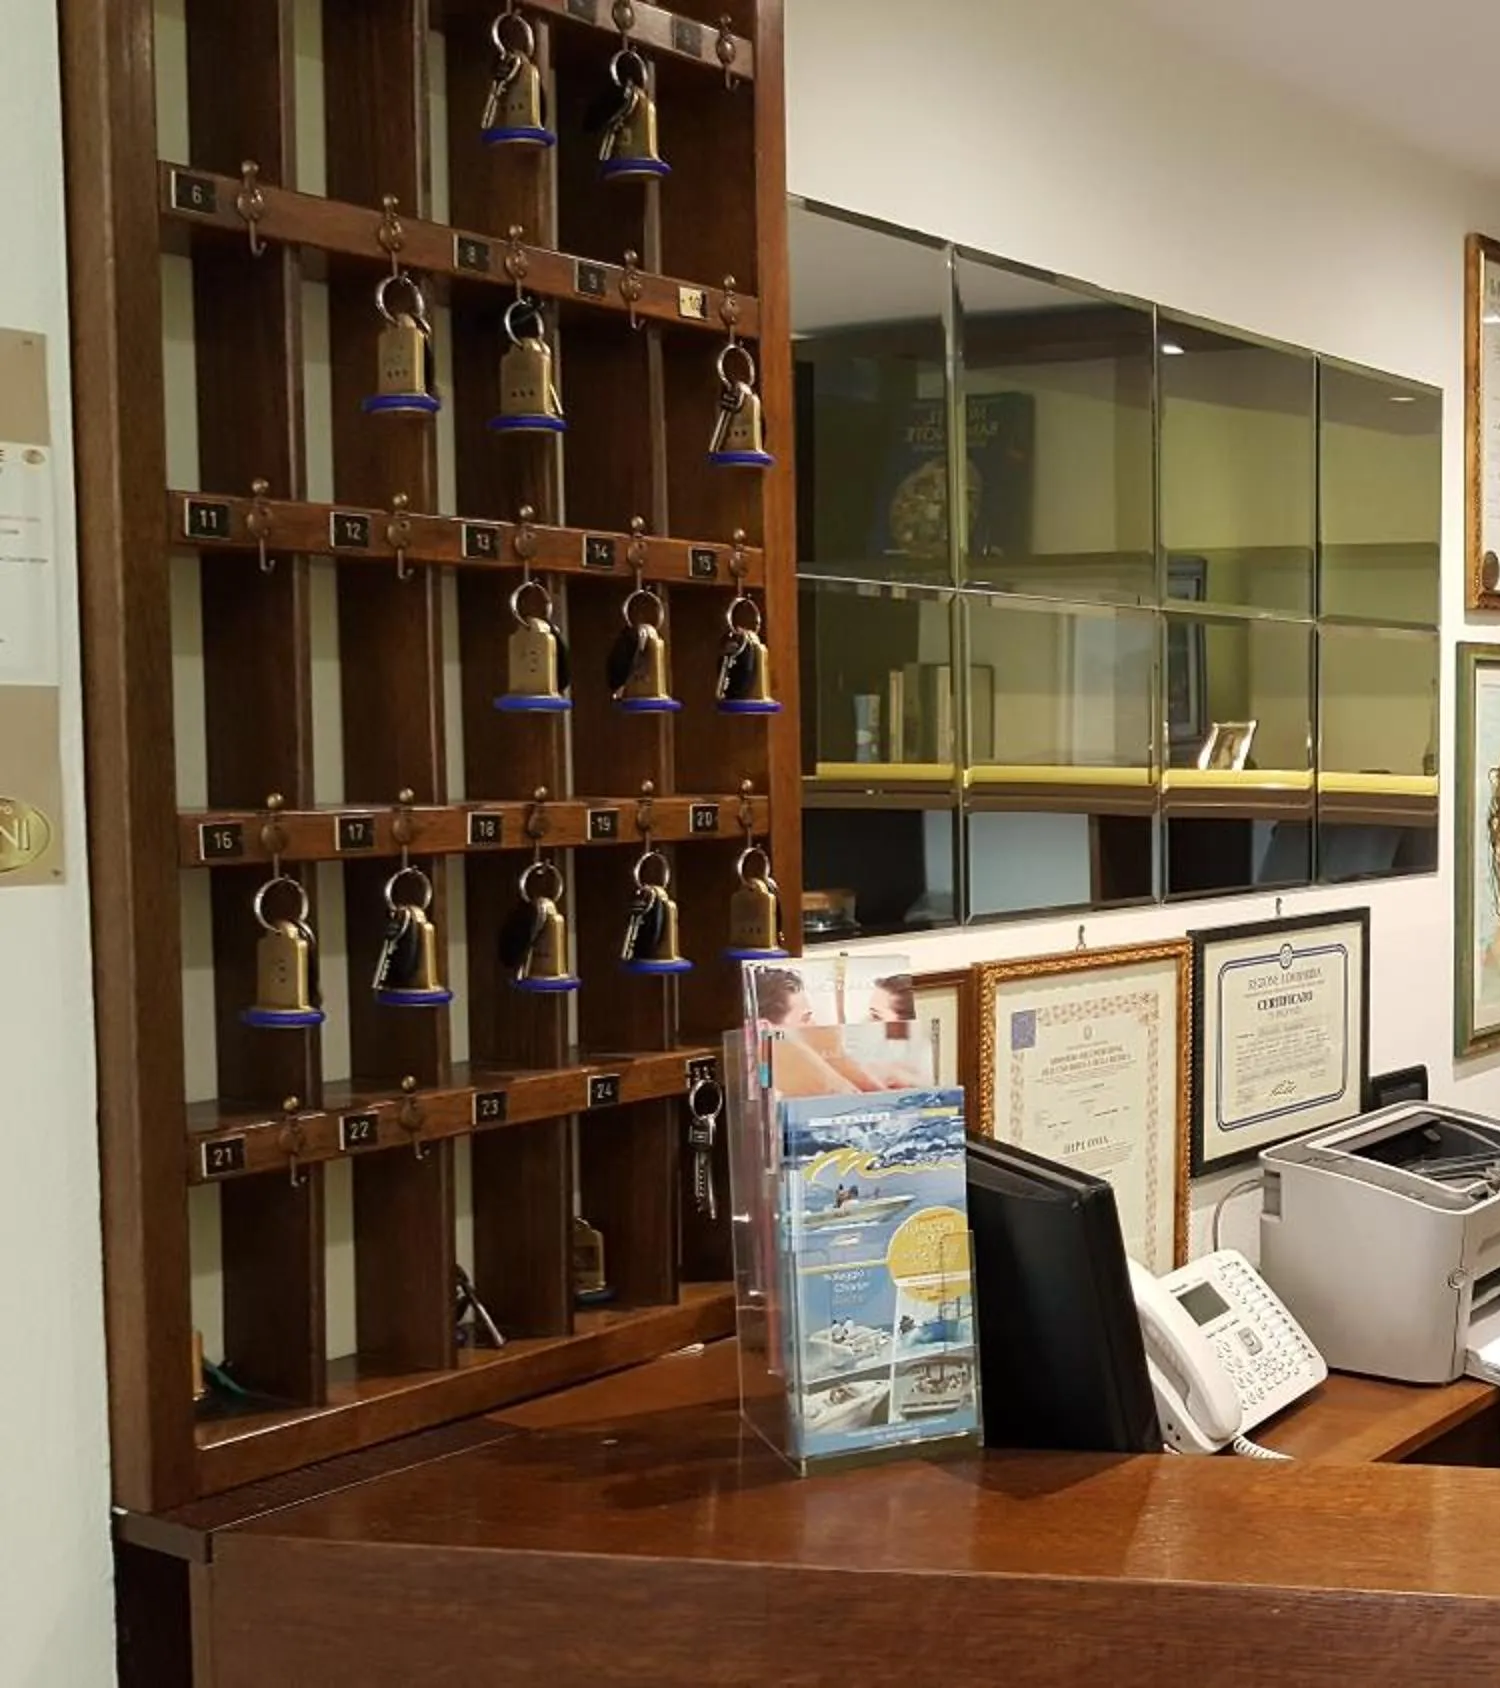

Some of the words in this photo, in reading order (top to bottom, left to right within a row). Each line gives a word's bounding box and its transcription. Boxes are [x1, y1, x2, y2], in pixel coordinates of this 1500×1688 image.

[199, 509, 218, 529] 11
[345, 521, 362, 540] 12
[475, 532, 490, 550] 13
[594, 543, 608, 560] 14
[596, 816, 612, 832] 19
[696, 811, 713, 828] 20
[348, 823, 365, 841] 17
[479, 821, 495, 838] 18
[213, 831, 233, 850] 16
[596, 1082, 613, 1100] 24
[481, 1098, 499, 1116] 23
[350, 1120, 370, 1140] 22
[213, 1147, 234, 1167] 21
